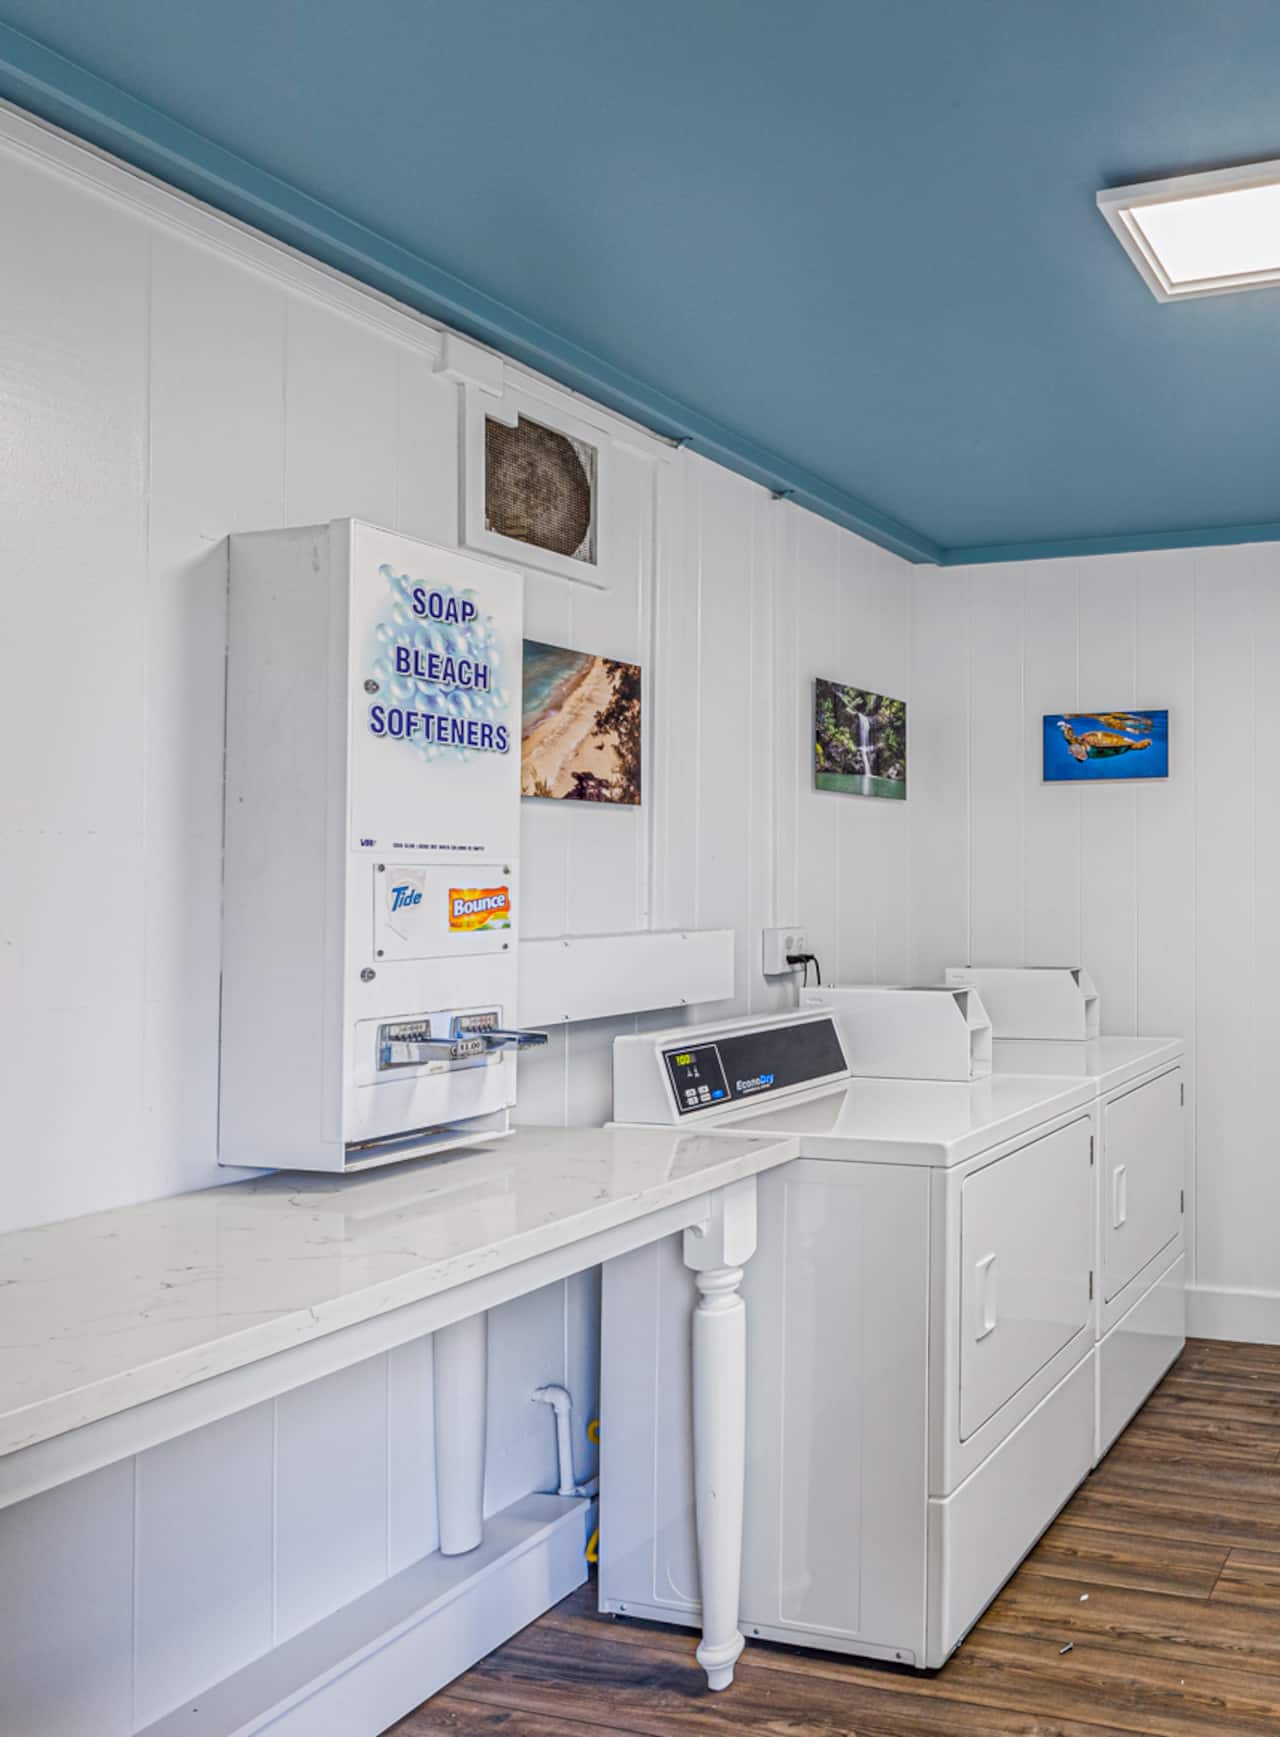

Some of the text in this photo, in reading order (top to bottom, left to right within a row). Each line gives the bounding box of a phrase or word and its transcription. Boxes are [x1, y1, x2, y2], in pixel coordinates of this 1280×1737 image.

[412, 586, 476, 625] SOAP
[395, 645, 489, 691] BLEACH
[369, 704, 509, 752] SOFTENERS
[391, 885, 423, 912] Tide
[453, 894, 506, 918] Bounce
[736, 1073, 775, 1091] EconoDry
